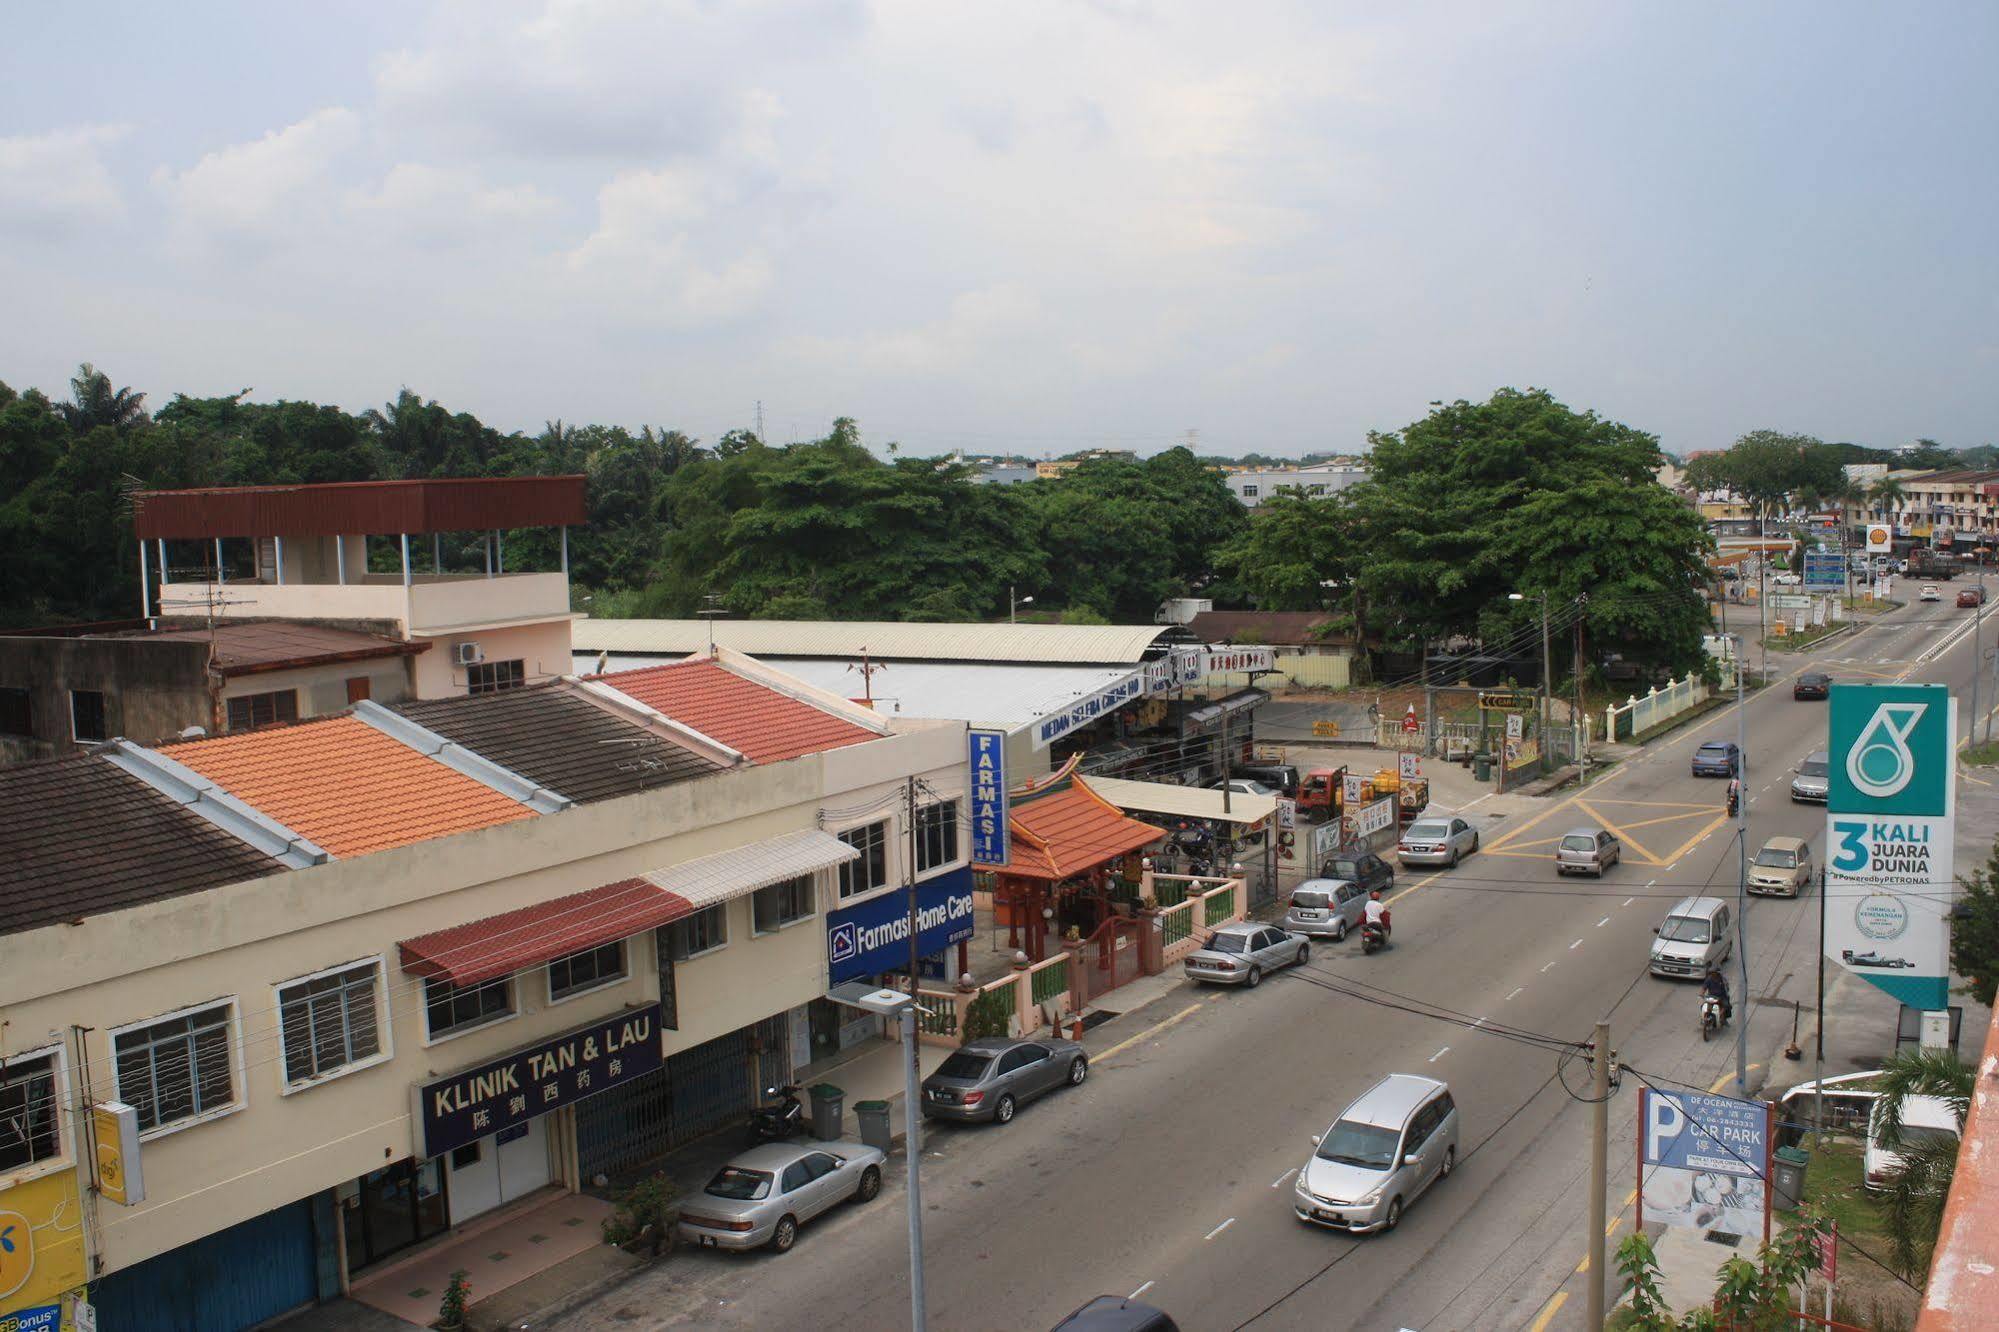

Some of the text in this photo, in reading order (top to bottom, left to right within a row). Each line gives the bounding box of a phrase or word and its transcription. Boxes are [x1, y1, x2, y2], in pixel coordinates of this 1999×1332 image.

[1041, 714, 1070, 741] MEDAN
[1128, 678, 1139, 696] HO
[978, 736, 995, 851] FARMASI
[1832, 821, 1868, 872] 3
[1871, 843, 1930, 858] JUARA
[1872, 823, 1928, 843] KALI
[1872, 858, 1929, 873] DUNIA
[857, 895, 972, 955] Farmasi Home Care
[434, 1016, 650, 1117] KLINIK TAN & LAU
[1649, 1093, 1683, 1160] P
[1703, 1098, 1733, 1109] OCEAN
[1690, 1122, 1761, 1145] CAR PARK
